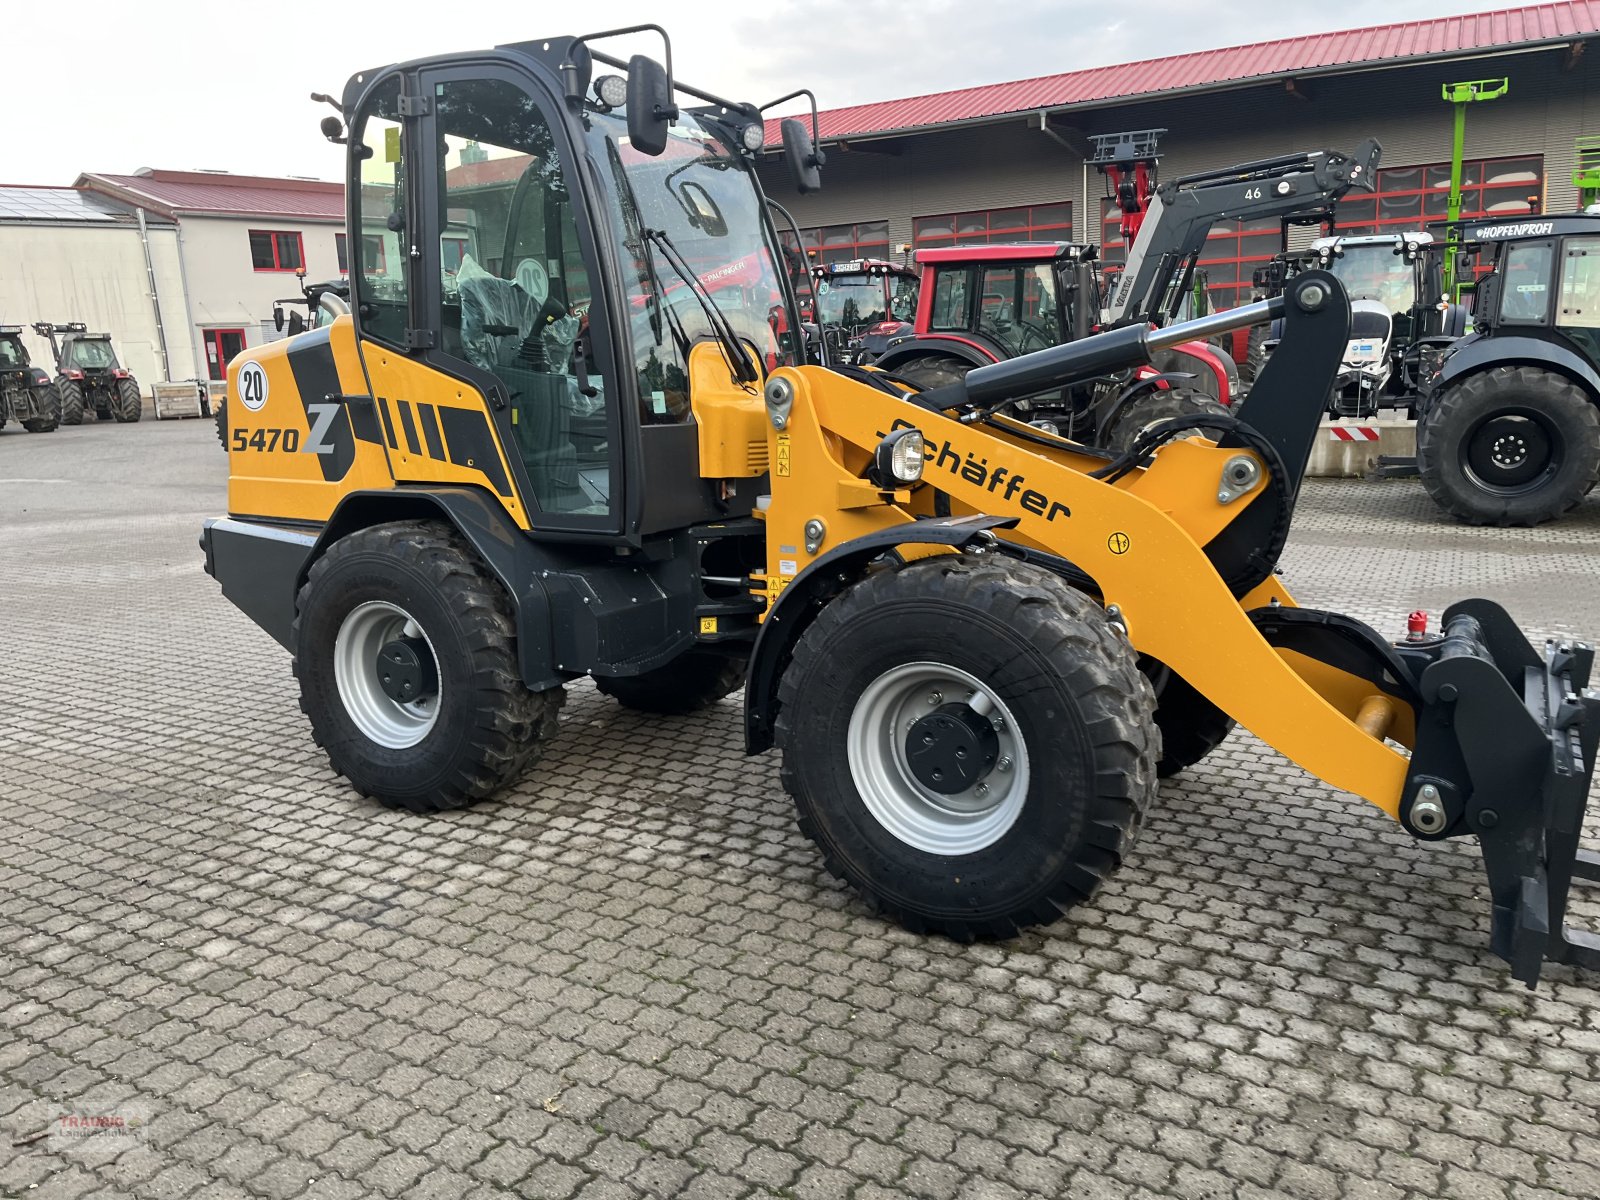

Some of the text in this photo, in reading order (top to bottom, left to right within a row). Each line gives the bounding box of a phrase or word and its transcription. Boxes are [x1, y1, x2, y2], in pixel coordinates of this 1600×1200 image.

[1244, 187, 1262, 200] 46
[1482, 222, 1554, 239] HOPFENPROFI
[243, 370, 263, 402] 20
[232, 403, 341, 454] 5470 Z
